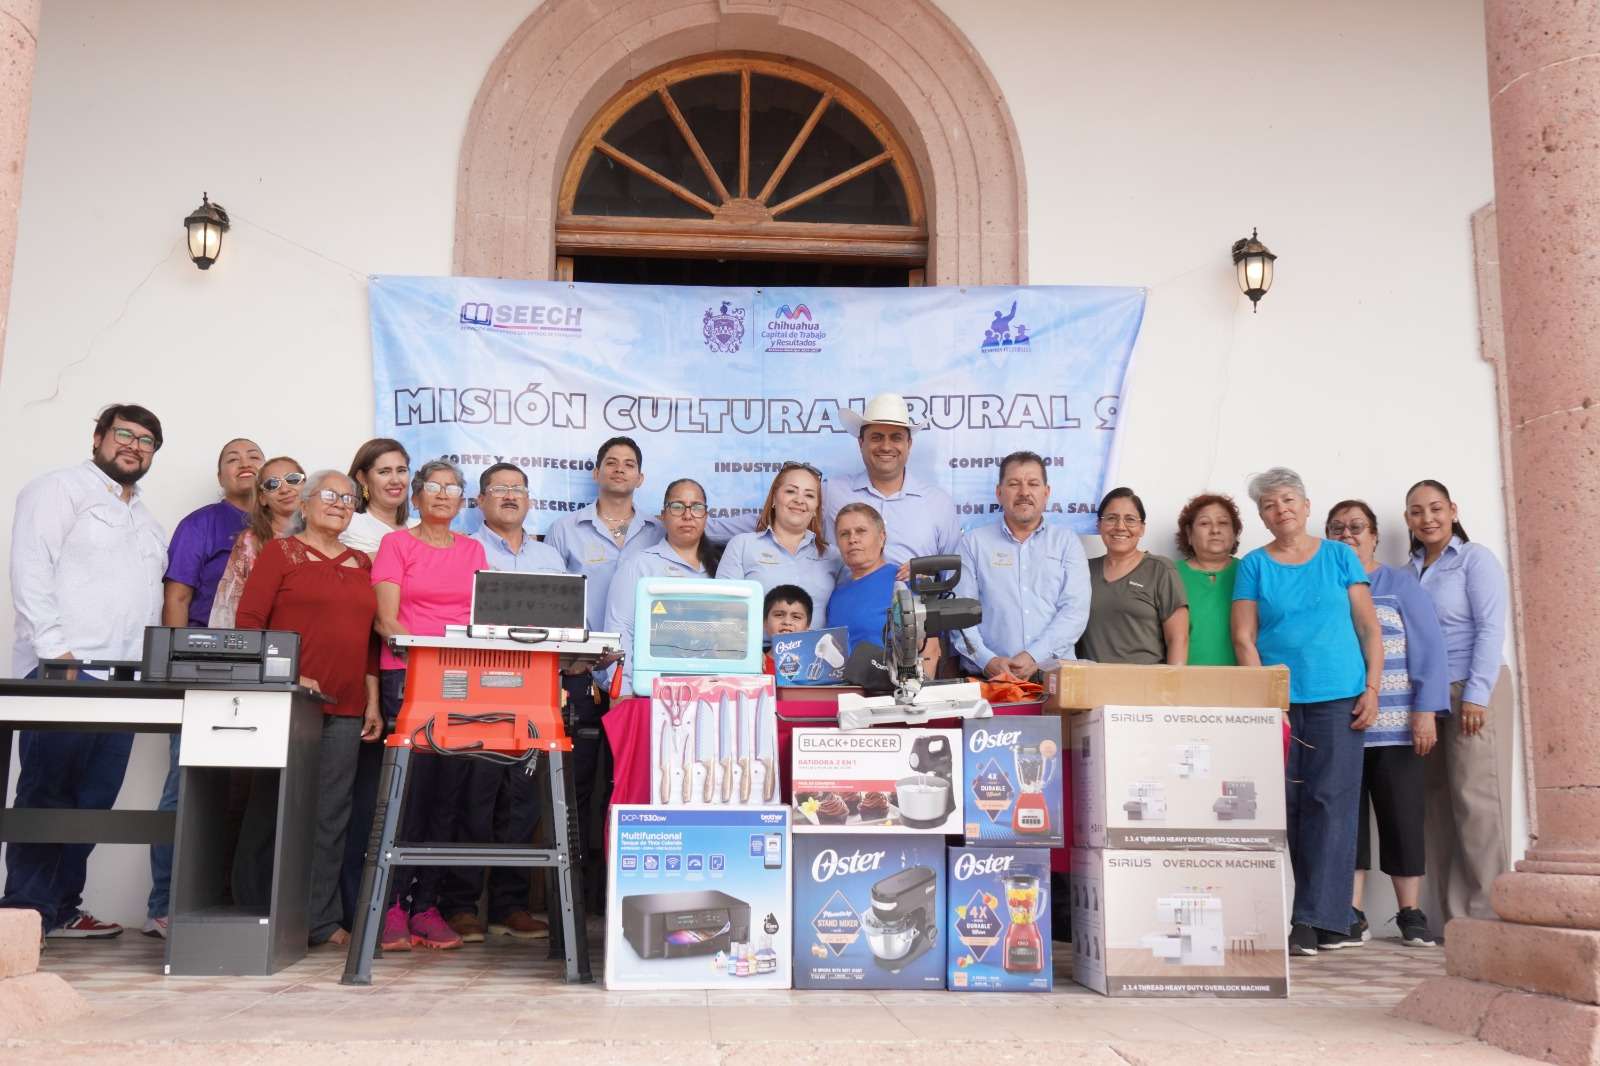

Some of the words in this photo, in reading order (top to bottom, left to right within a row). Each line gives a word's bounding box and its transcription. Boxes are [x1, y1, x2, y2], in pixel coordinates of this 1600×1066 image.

[495, 305, 582, 325] SEECH
[768, 321, 820, 331] Chihuahua
[761, 331, 788, 340] Capital
[788, 331, 798, 339] de
[800, 331, 826, 340] Trabajo
[777, 339, 817, 347] Resultados
[395, 383, 586, 429] MISIÓN
[509, 457, 596, 471] CONFECCIÓ
[949, 457, 1064, 468] COMPUON
[1067, 502, 1098, 514] SAL
[775, 639, 803, 655] Oster
[1163, 714, 1223, 724] OVERLOCK
[1225, 715, 1275, 725] MACHINE
[803, 738, 897, 748] BLACK+DECKER
[969, 729, 1022, 753] Oster
[621, 832, 682, 840] Multifuncional
[811, 849, 886, 882] Oster
[954, 853, 1014, 880] Oster
[1163, 859, 1223, 868] OVERLOCK
[1225, 859, 1276, 869] MACHINE
[970, 907, 987, 919] 4X
[1138, 984, 1164, 992] THREAD
